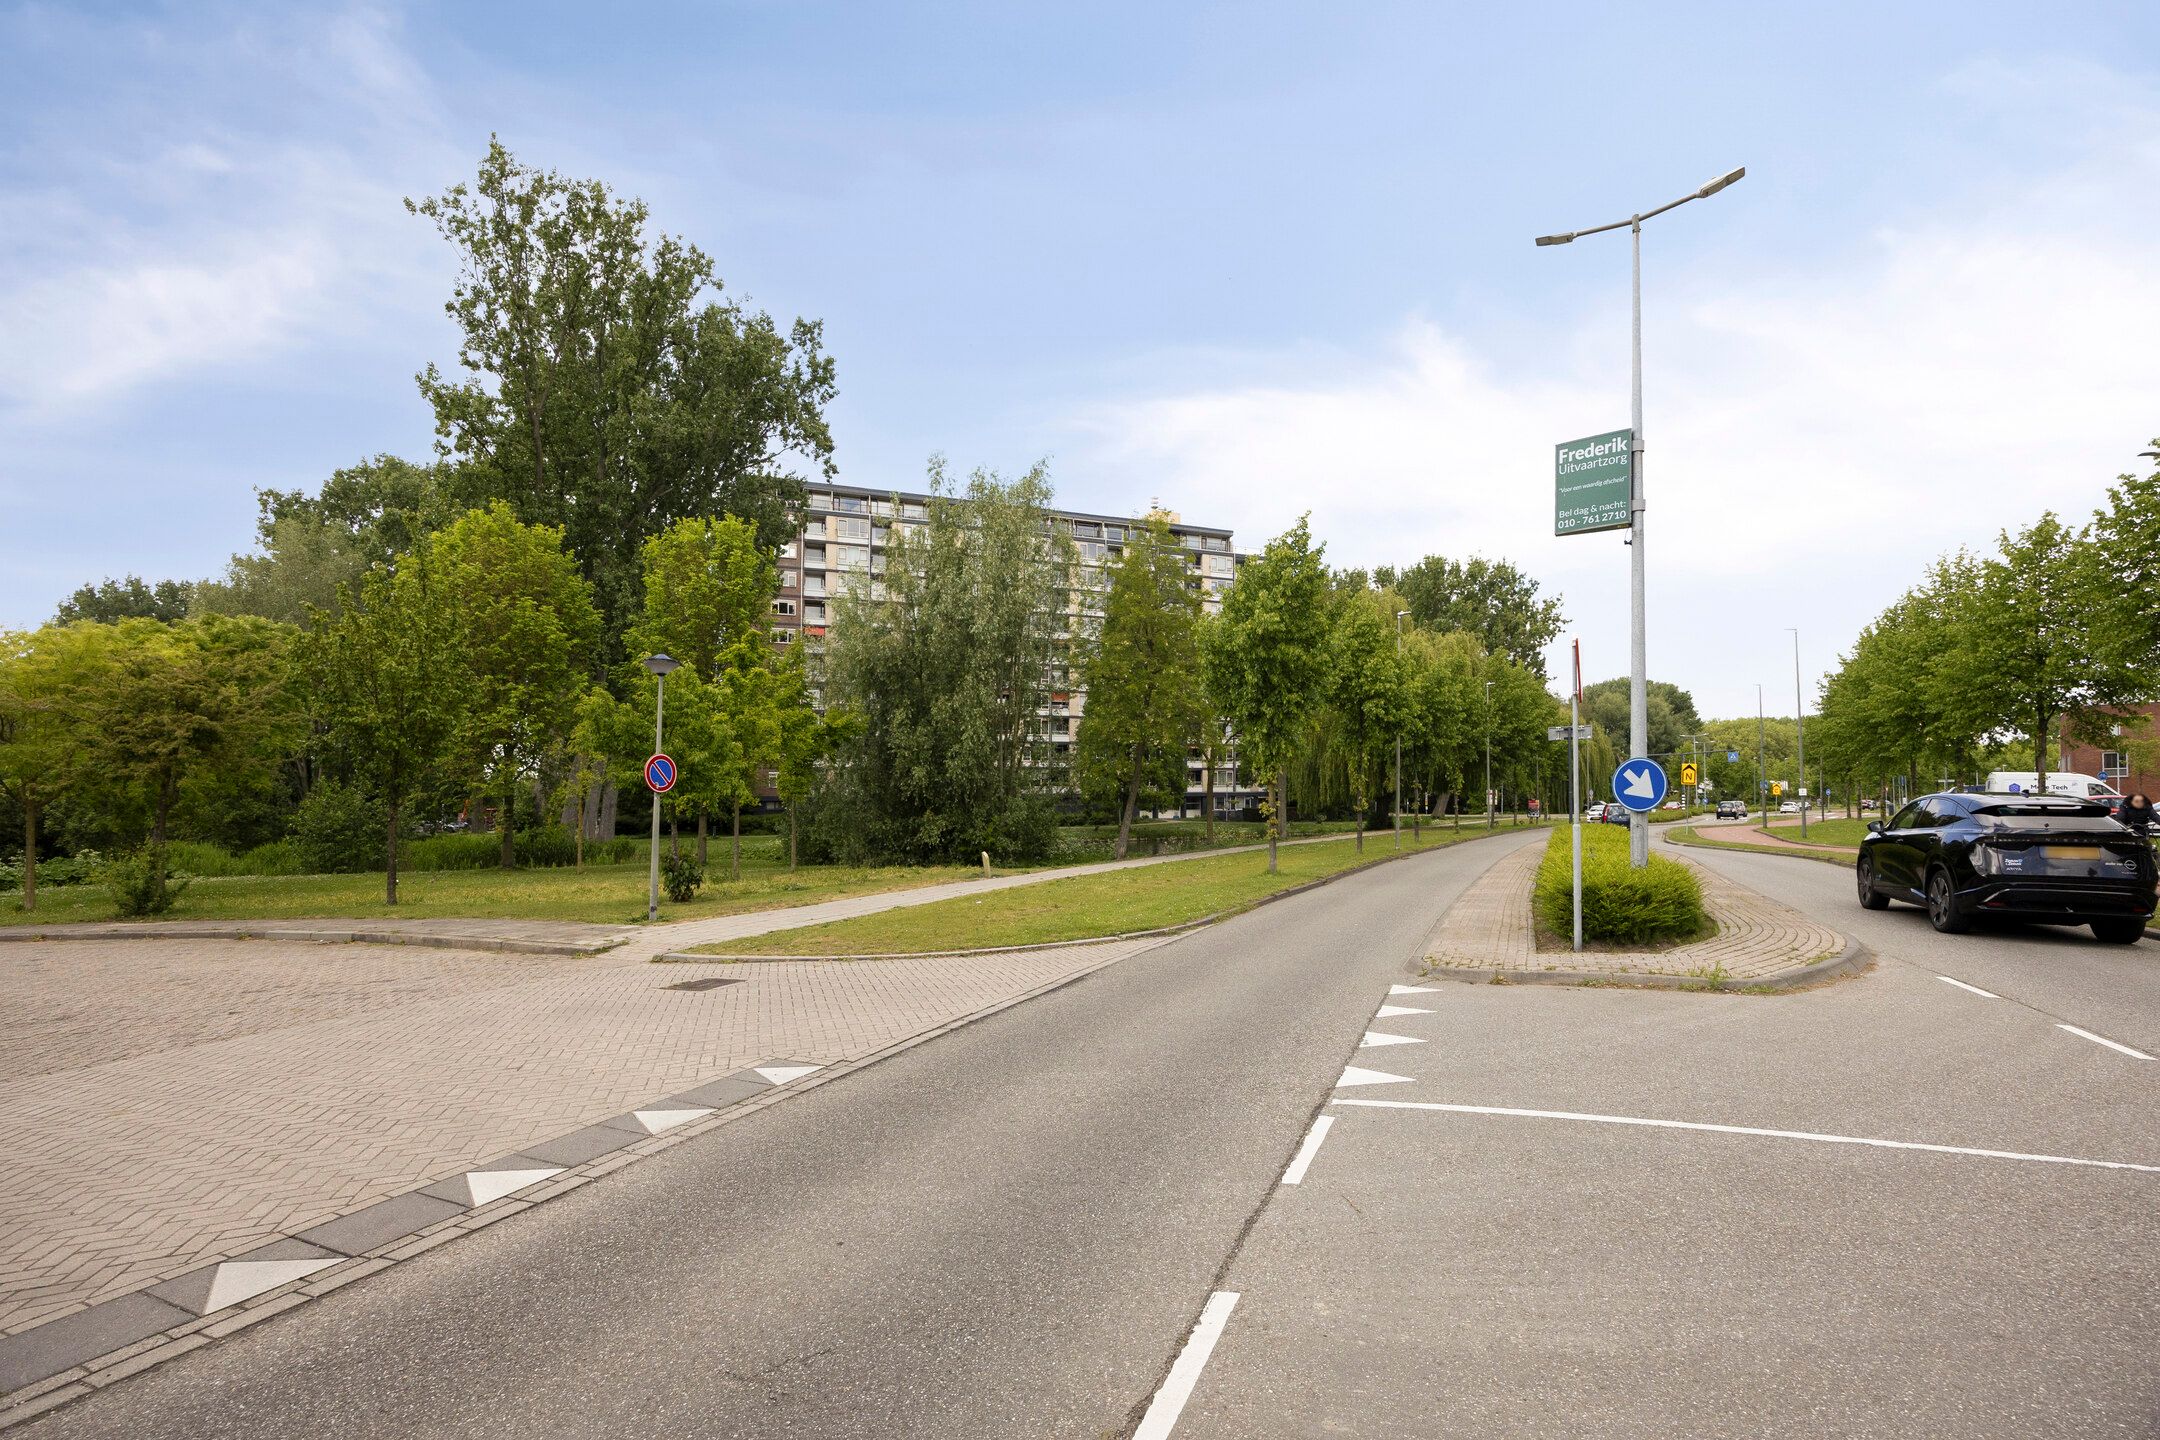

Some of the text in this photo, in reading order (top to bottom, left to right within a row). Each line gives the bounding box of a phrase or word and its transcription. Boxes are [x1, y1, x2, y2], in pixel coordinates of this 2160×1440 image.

[1559, 437, 1628, 464] Frederik
[1559, 454, 1628, 475] Uitvaartzorg
[1558, 519, 1575, 529] 010
[1582, 514, 1600, 524] 761
[1602, 510, 1627, 521] 2710
[1559, 509, 1572, 519] Bel
[1574, 507, 1589, 515] dag
[1600, 501, 1626, 511] nacht:
